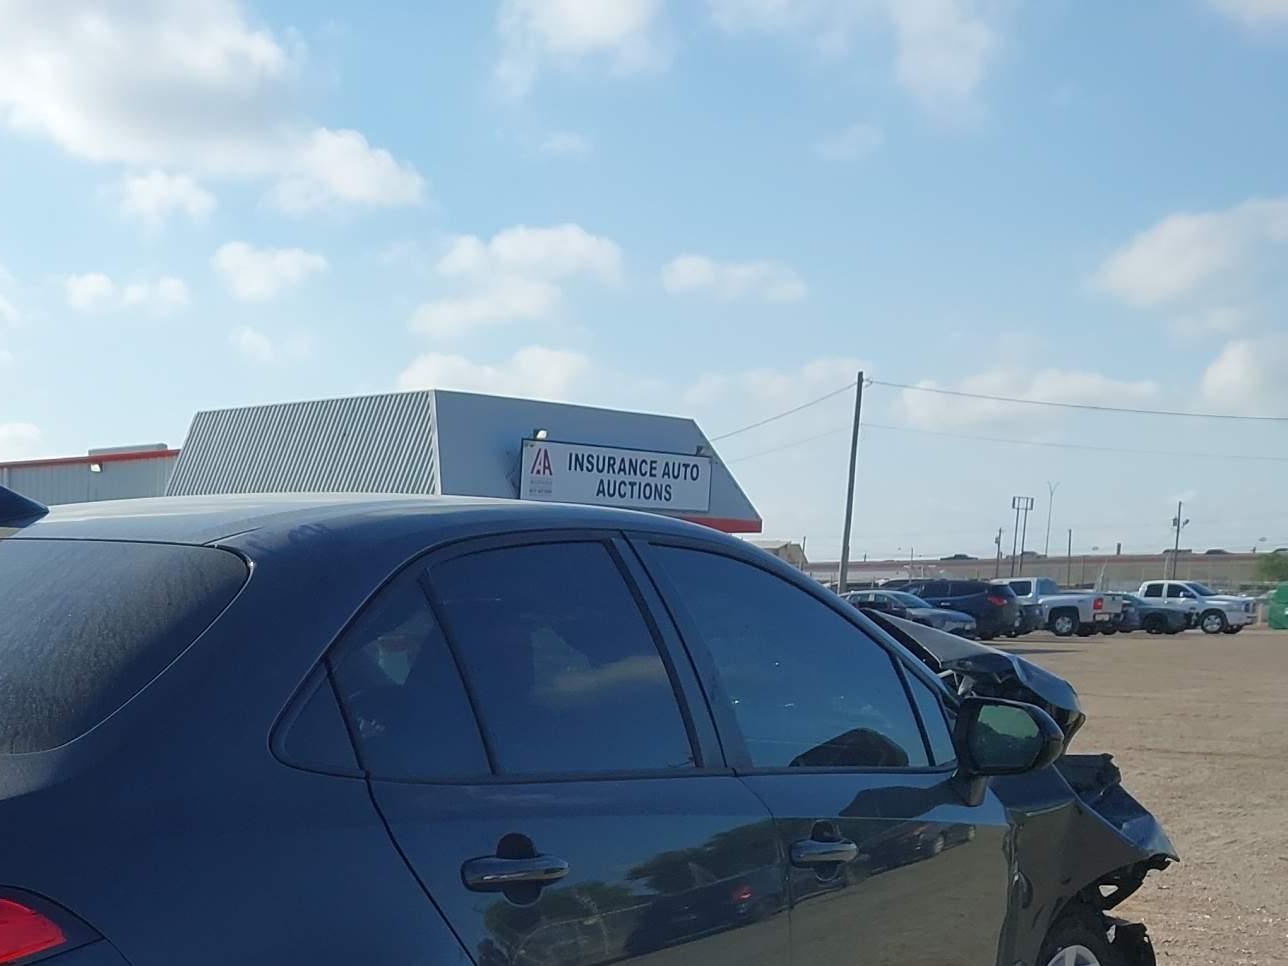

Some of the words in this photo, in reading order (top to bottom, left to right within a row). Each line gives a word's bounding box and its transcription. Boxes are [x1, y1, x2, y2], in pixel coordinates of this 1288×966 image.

[567, 452, 657, 477] INSURANCE
[662, 461, 700, 481] AUTO
[596, 478, 673, 501] AUCTIONS
